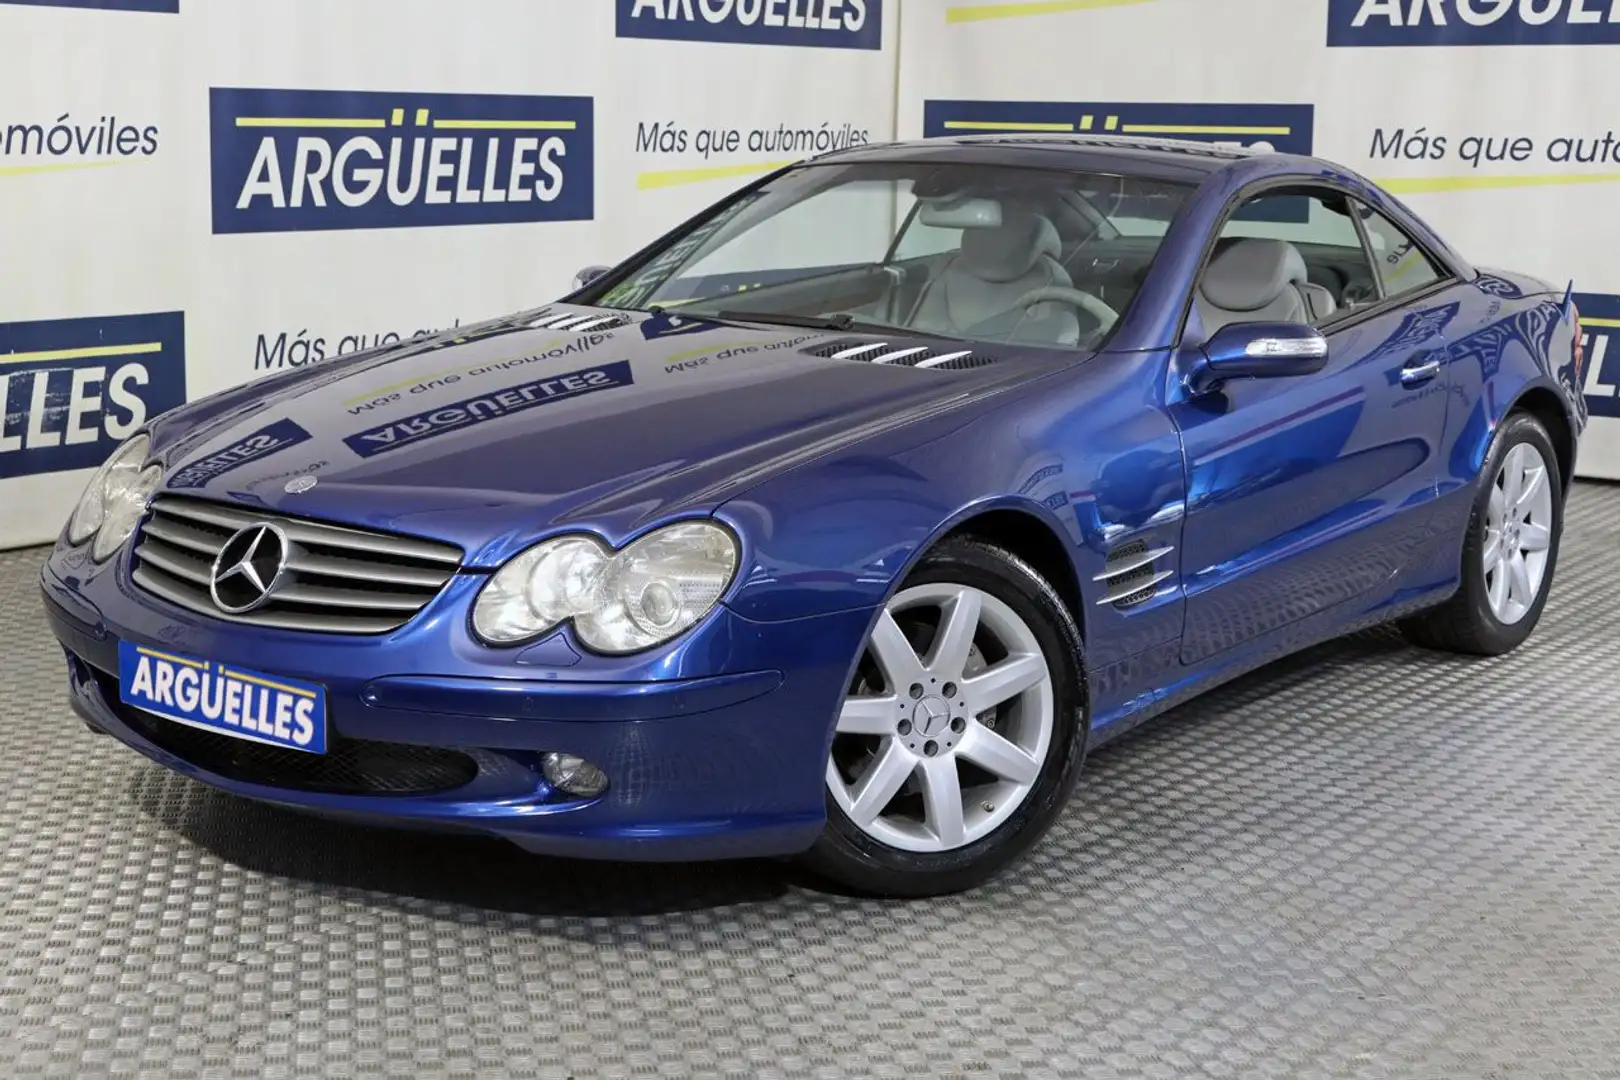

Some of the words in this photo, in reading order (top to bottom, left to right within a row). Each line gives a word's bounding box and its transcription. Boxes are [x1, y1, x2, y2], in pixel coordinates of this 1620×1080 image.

[0, 112, 158, 156] móviles
[636, 121, 688, 152] Más
[695, 130, 740, 159] que
[747, 122, 868, 151] automóviles
[1369, 127, 1447, 160] Más
[1458, 137, 1533, 168] que
[236, 108, 566, 209] ARGÜELLES
[255, 329, 326, 370] Más
[130, 655, 315, 746] ARGÜELLES
